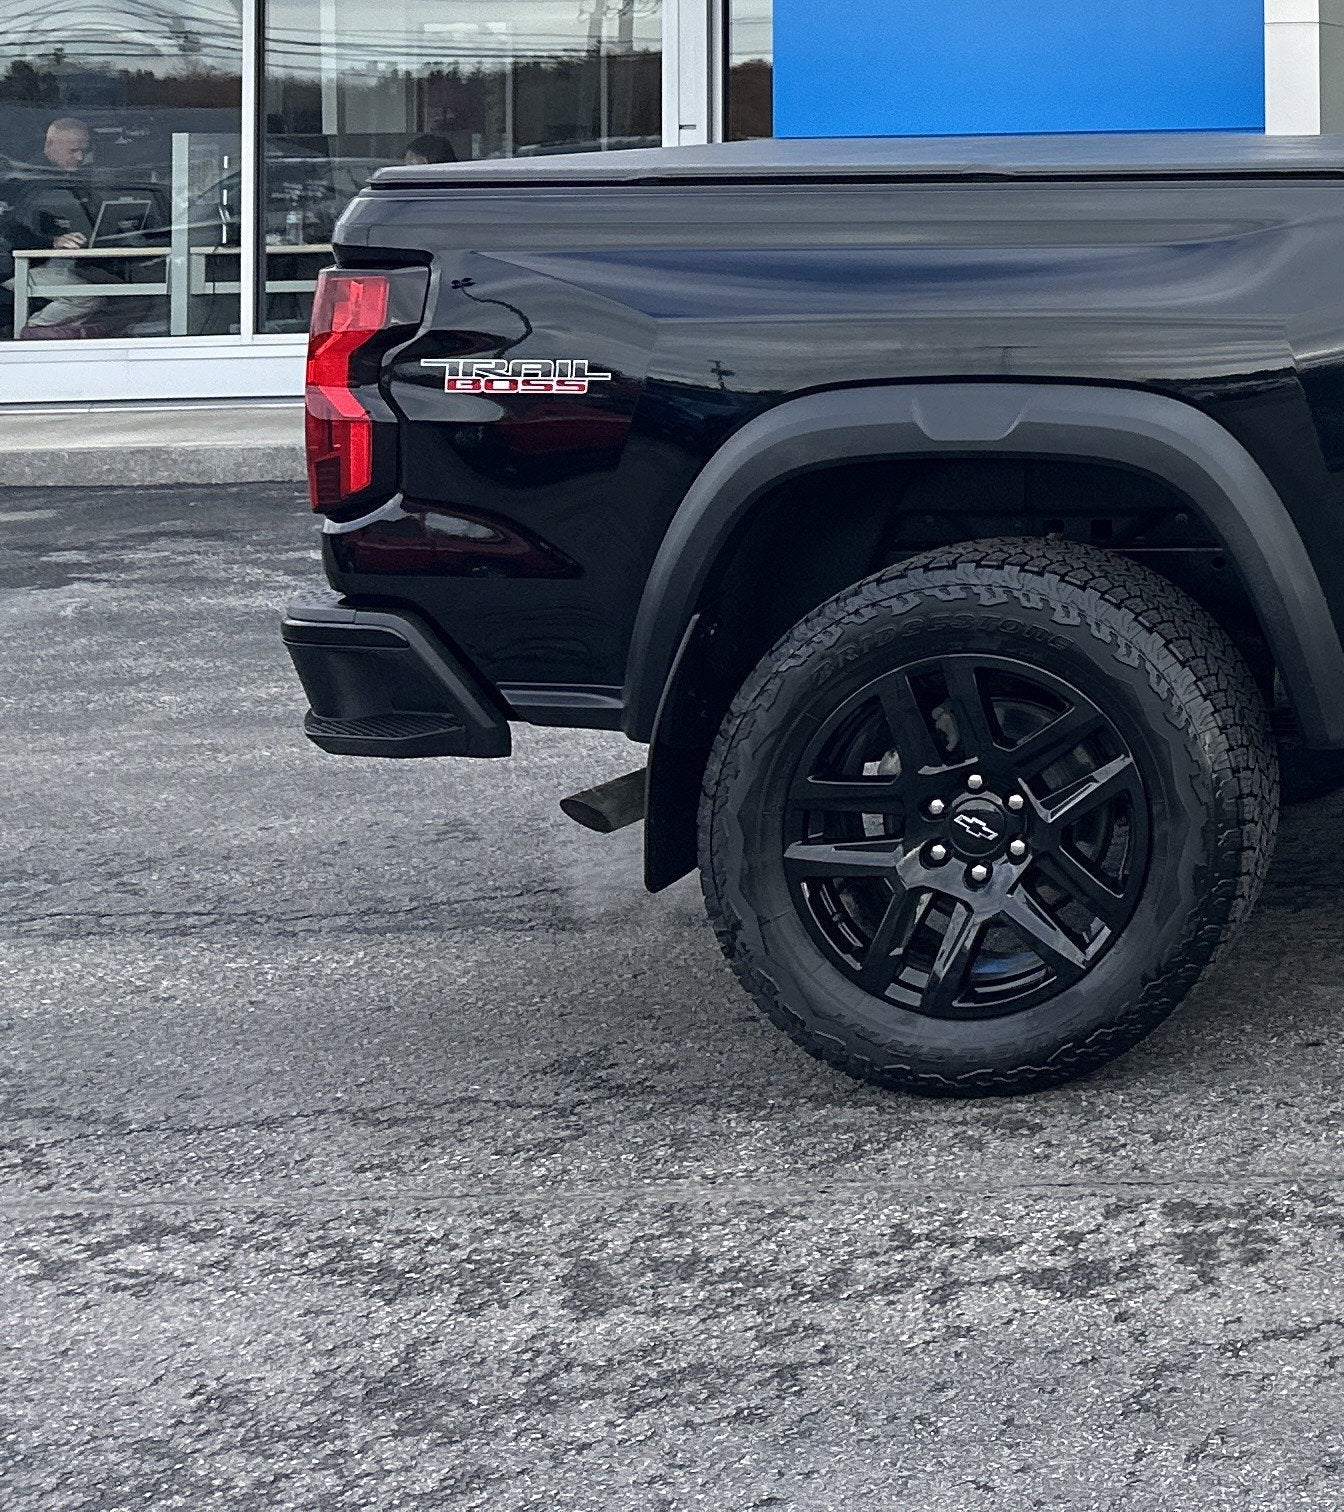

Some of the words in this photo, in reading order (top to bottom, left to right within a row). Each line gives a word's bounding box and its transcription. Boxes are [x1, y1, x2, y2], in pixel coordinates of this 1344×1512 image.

[420, 359, 612, 380] TRAIL
[444, 377, 588, 394] BOSS
[811, 612, 1075, 686] BRIDGESTONE
